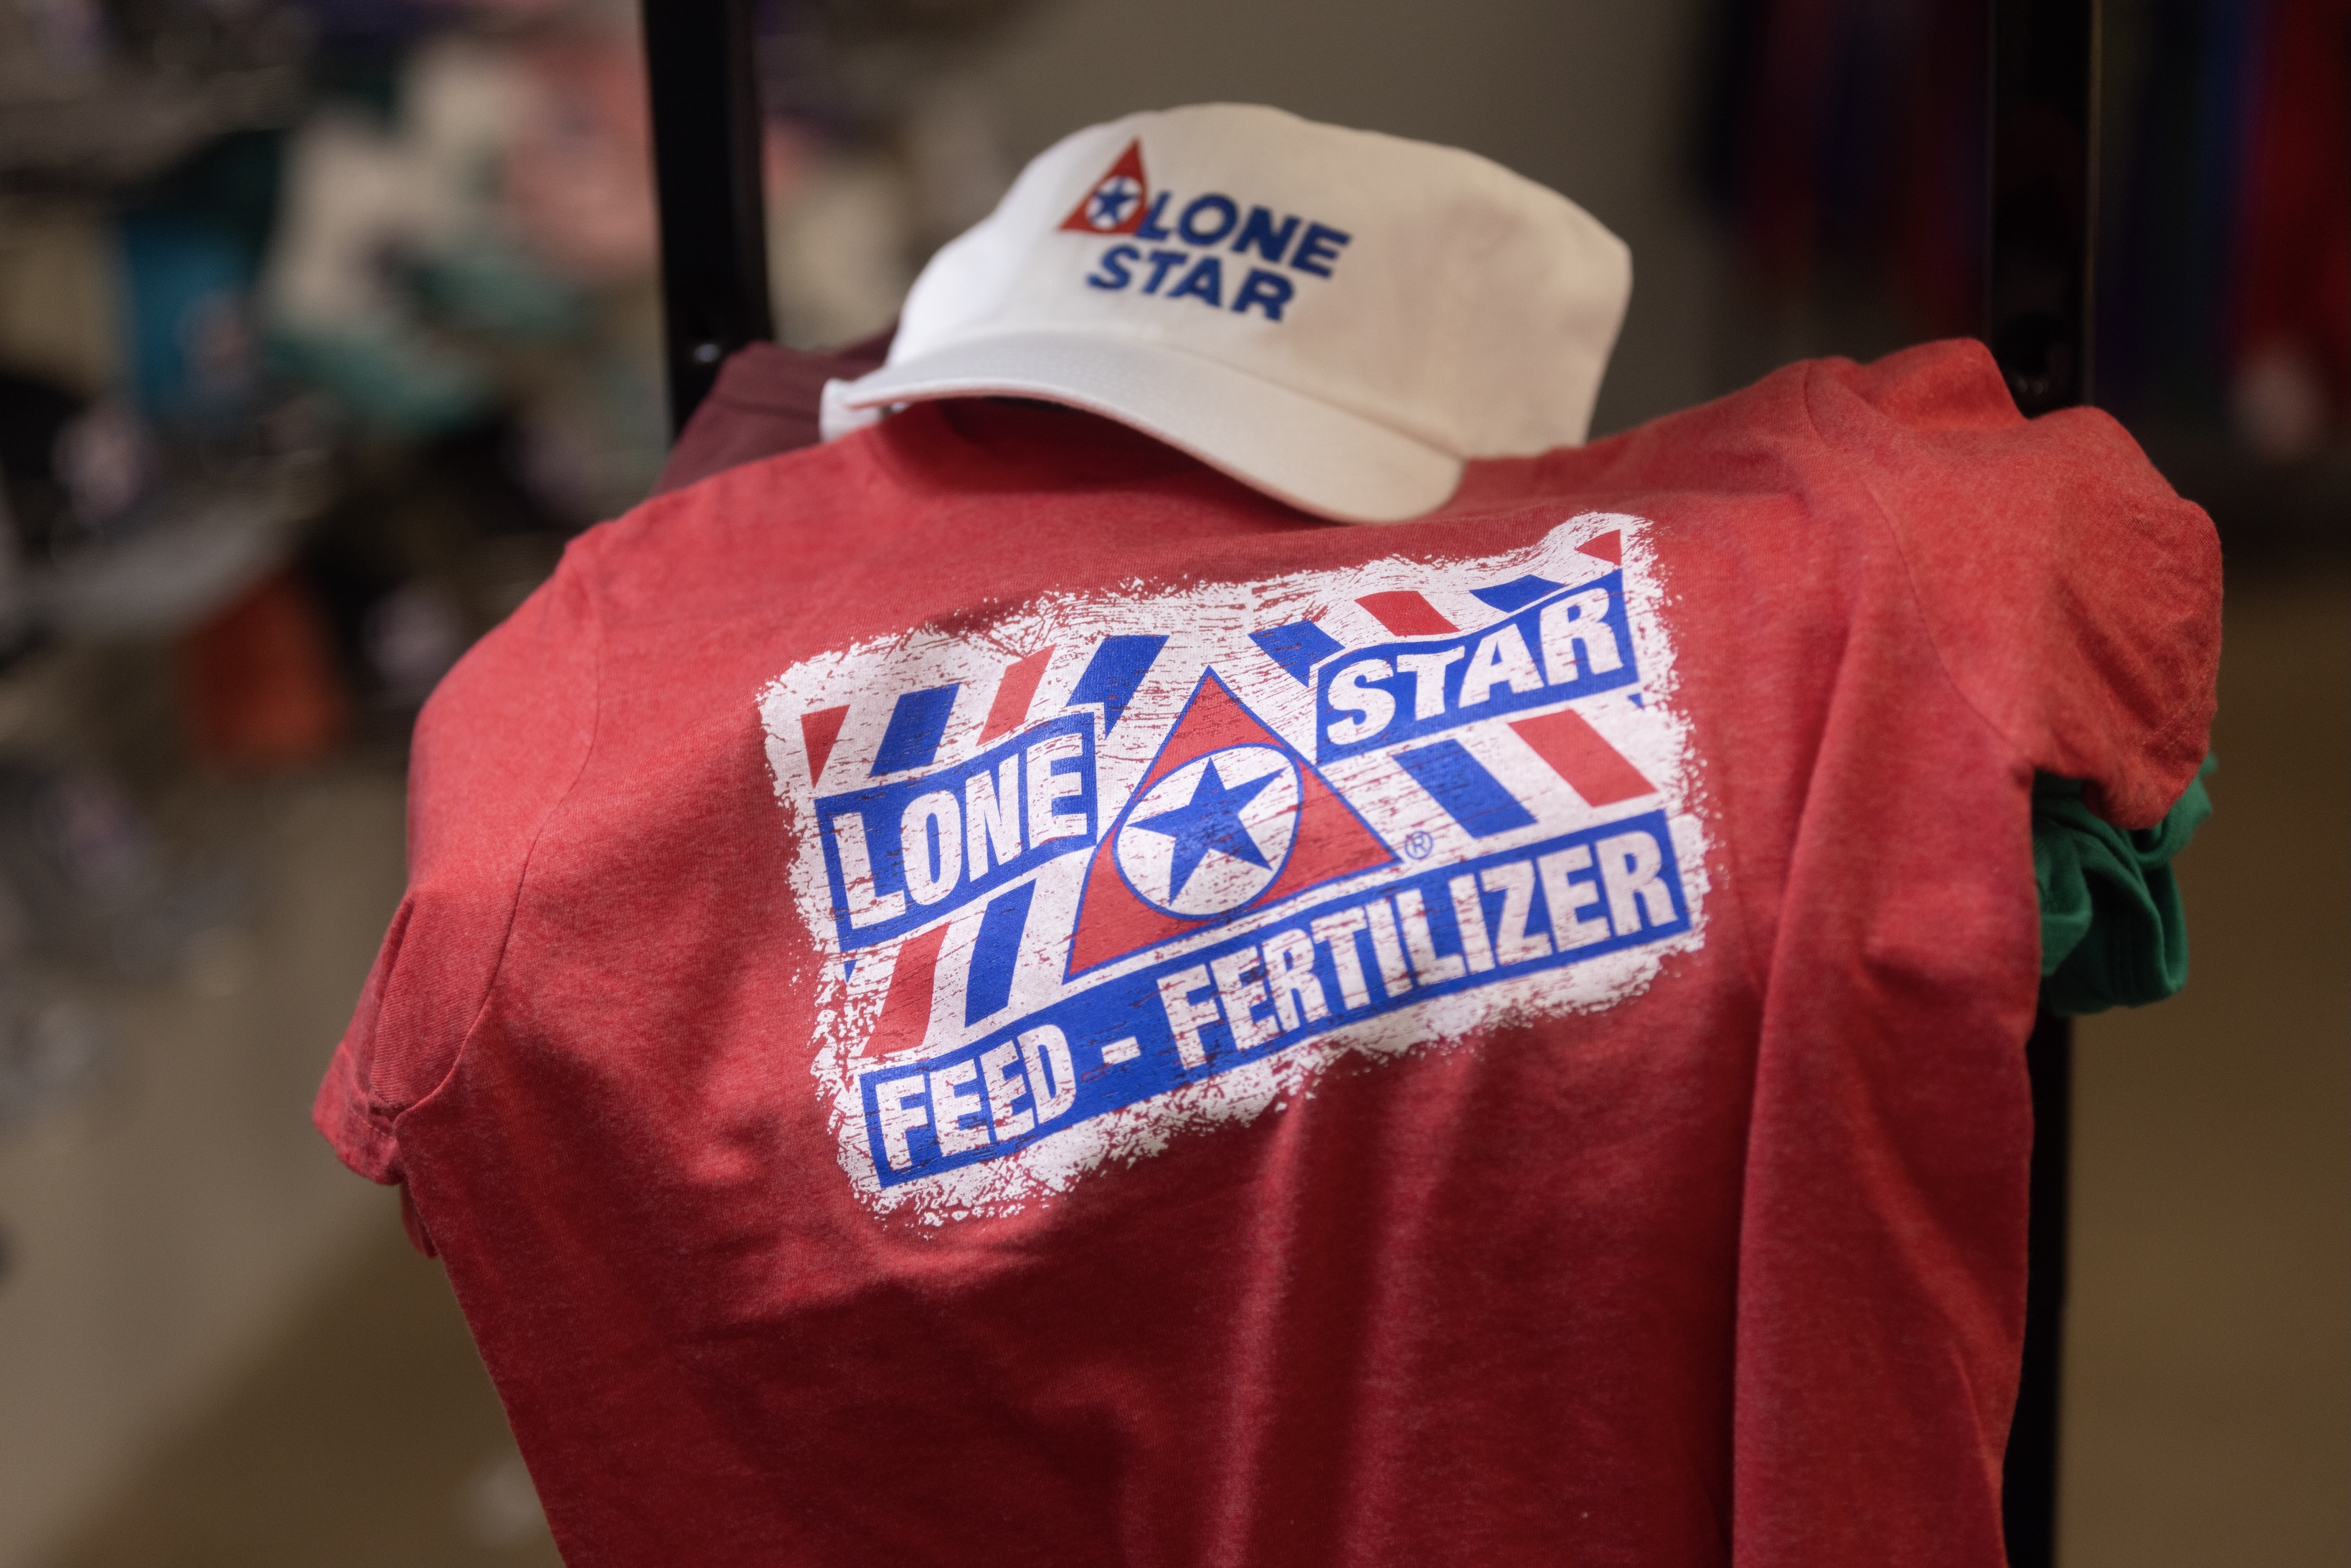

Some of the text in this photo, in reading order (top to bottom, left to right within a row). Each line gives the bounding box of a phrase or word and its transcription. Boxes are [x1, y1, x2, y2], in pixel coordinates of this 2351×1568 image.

[1086, 244, 1295, 322] STAR
[1134, 191, 1353, 280] LONE
[831, 587, 1625, 931] LONE STAR
[874, 1024, 1078, 1173] FEED
[1156, 830, 1680, 1073] FERTILIZER
